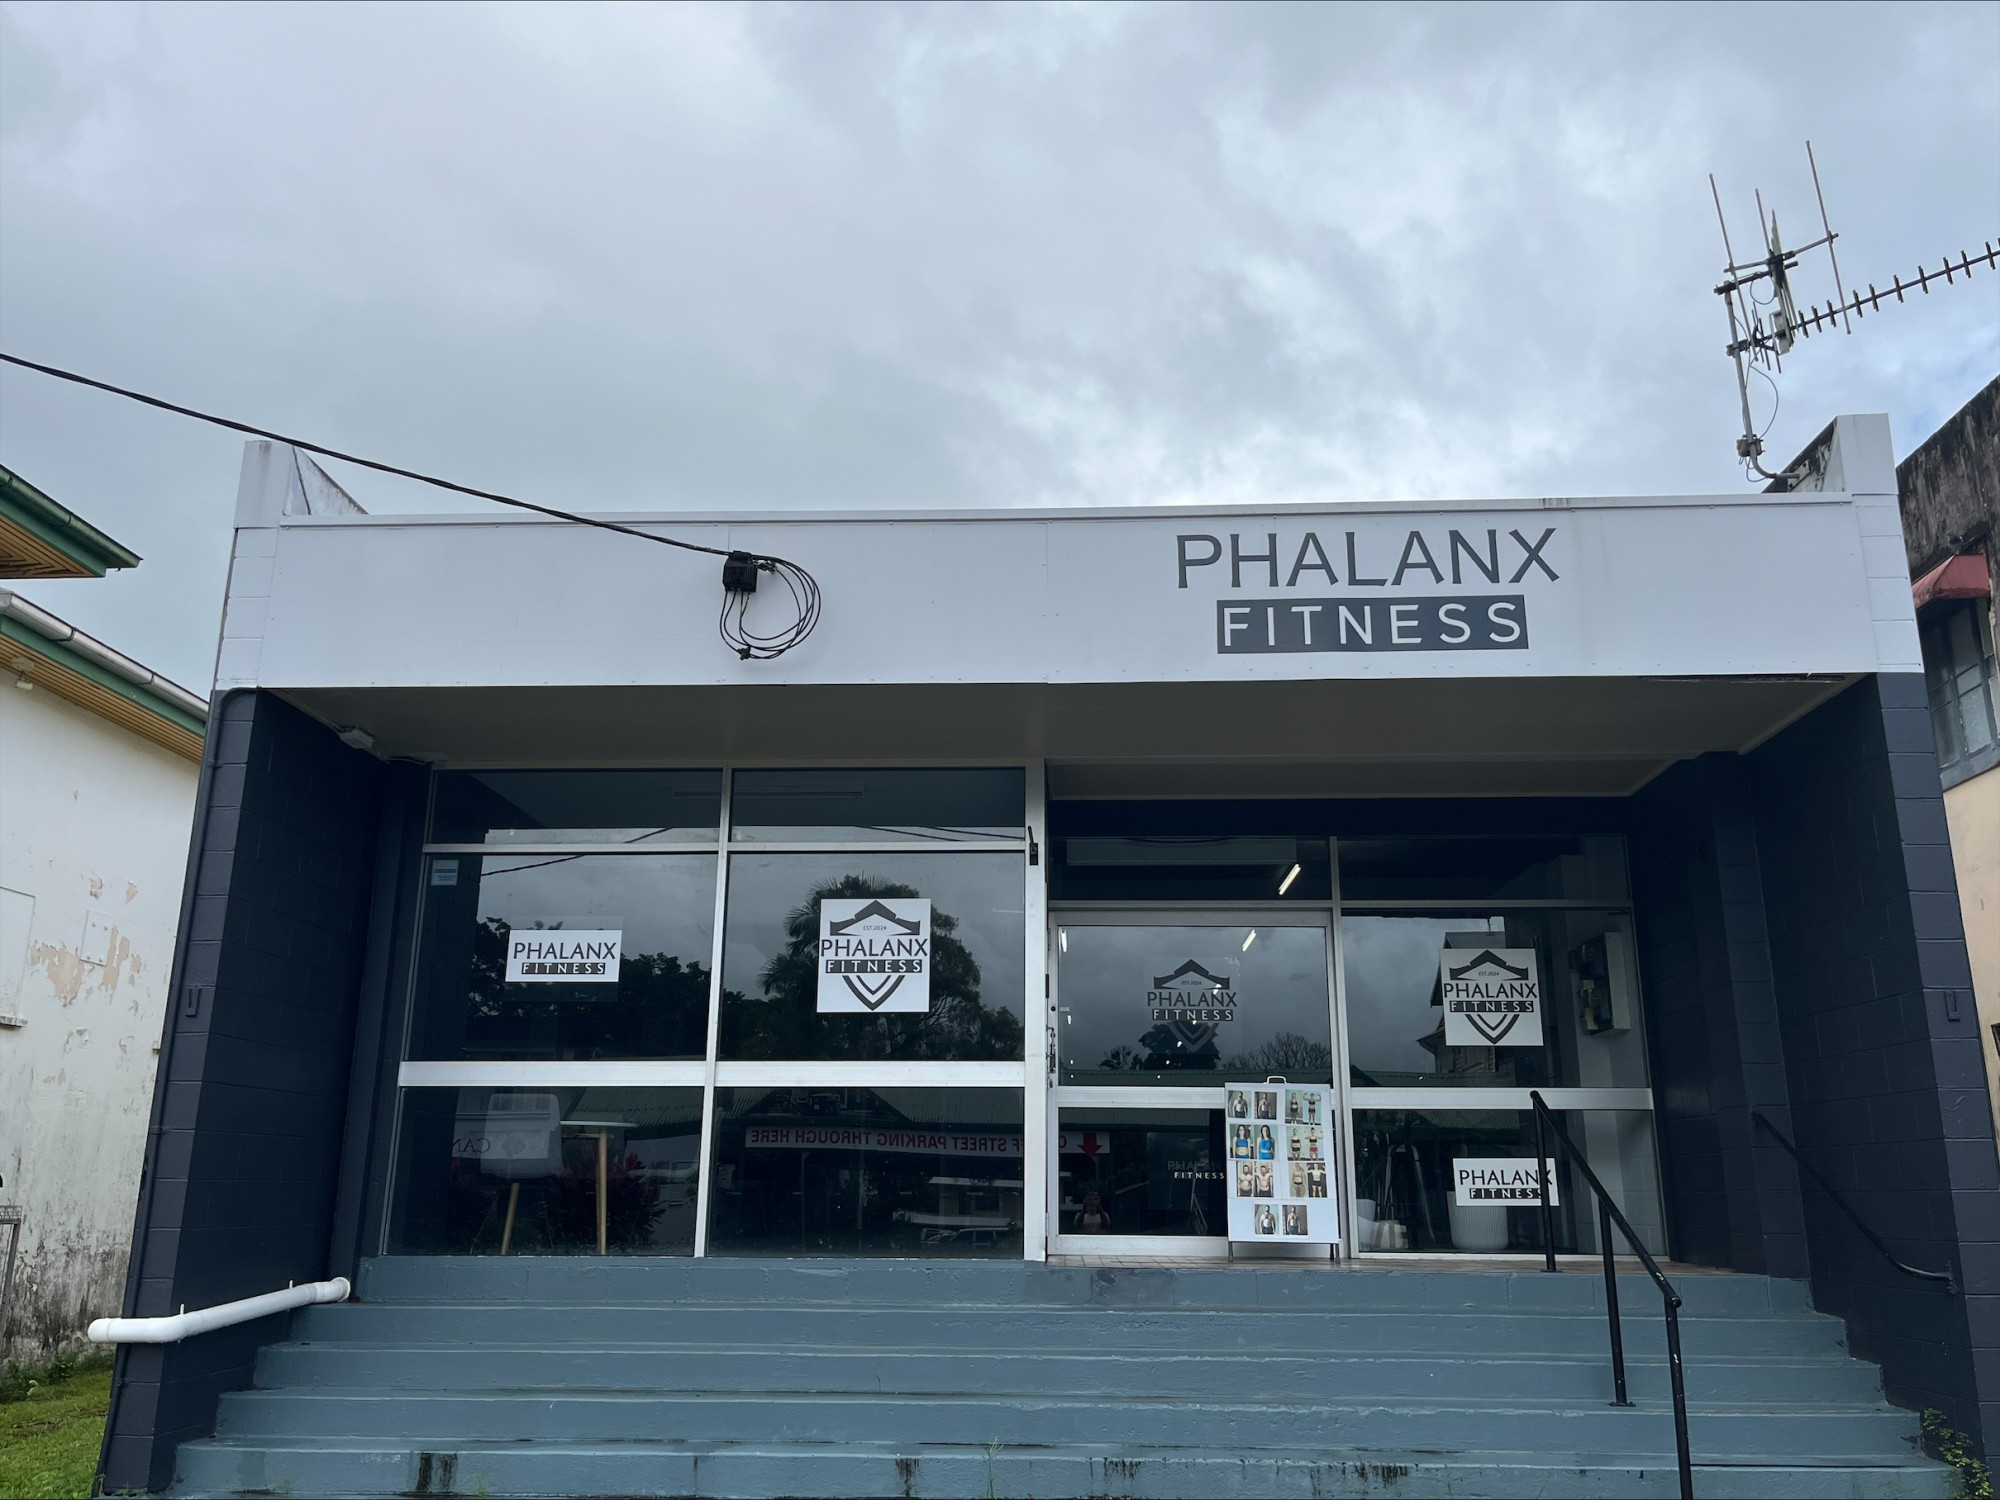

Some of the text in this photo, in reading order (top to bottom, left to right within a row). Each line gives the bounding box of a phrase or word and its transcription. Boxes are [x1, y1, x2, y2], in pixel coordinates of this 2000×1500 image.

[1176, 527, 1560, 589] PHALANX
[1223, 601, 1522, 647] FITNESS
[862, 924, 888, 932] EST.2024
[513, 942, 617, 960] PHALANX
[820, 938, 929, 957] PHALANX
[522, 963, 605, 975] FITNESS
[826, 960, 922, 973] FITNESS
[1442, 982, 1538, 999] PHALANX
[1146, 991, 1238, 1008] PHALANX
[1450, 1001, 1534, 1012] FITNESS
[1152, 1009, 1233, 1021] FITNESS
[1167, 1160, 1226, 1173] PHALAN
[1173, 1171, 1225, 1180] FITNESS
